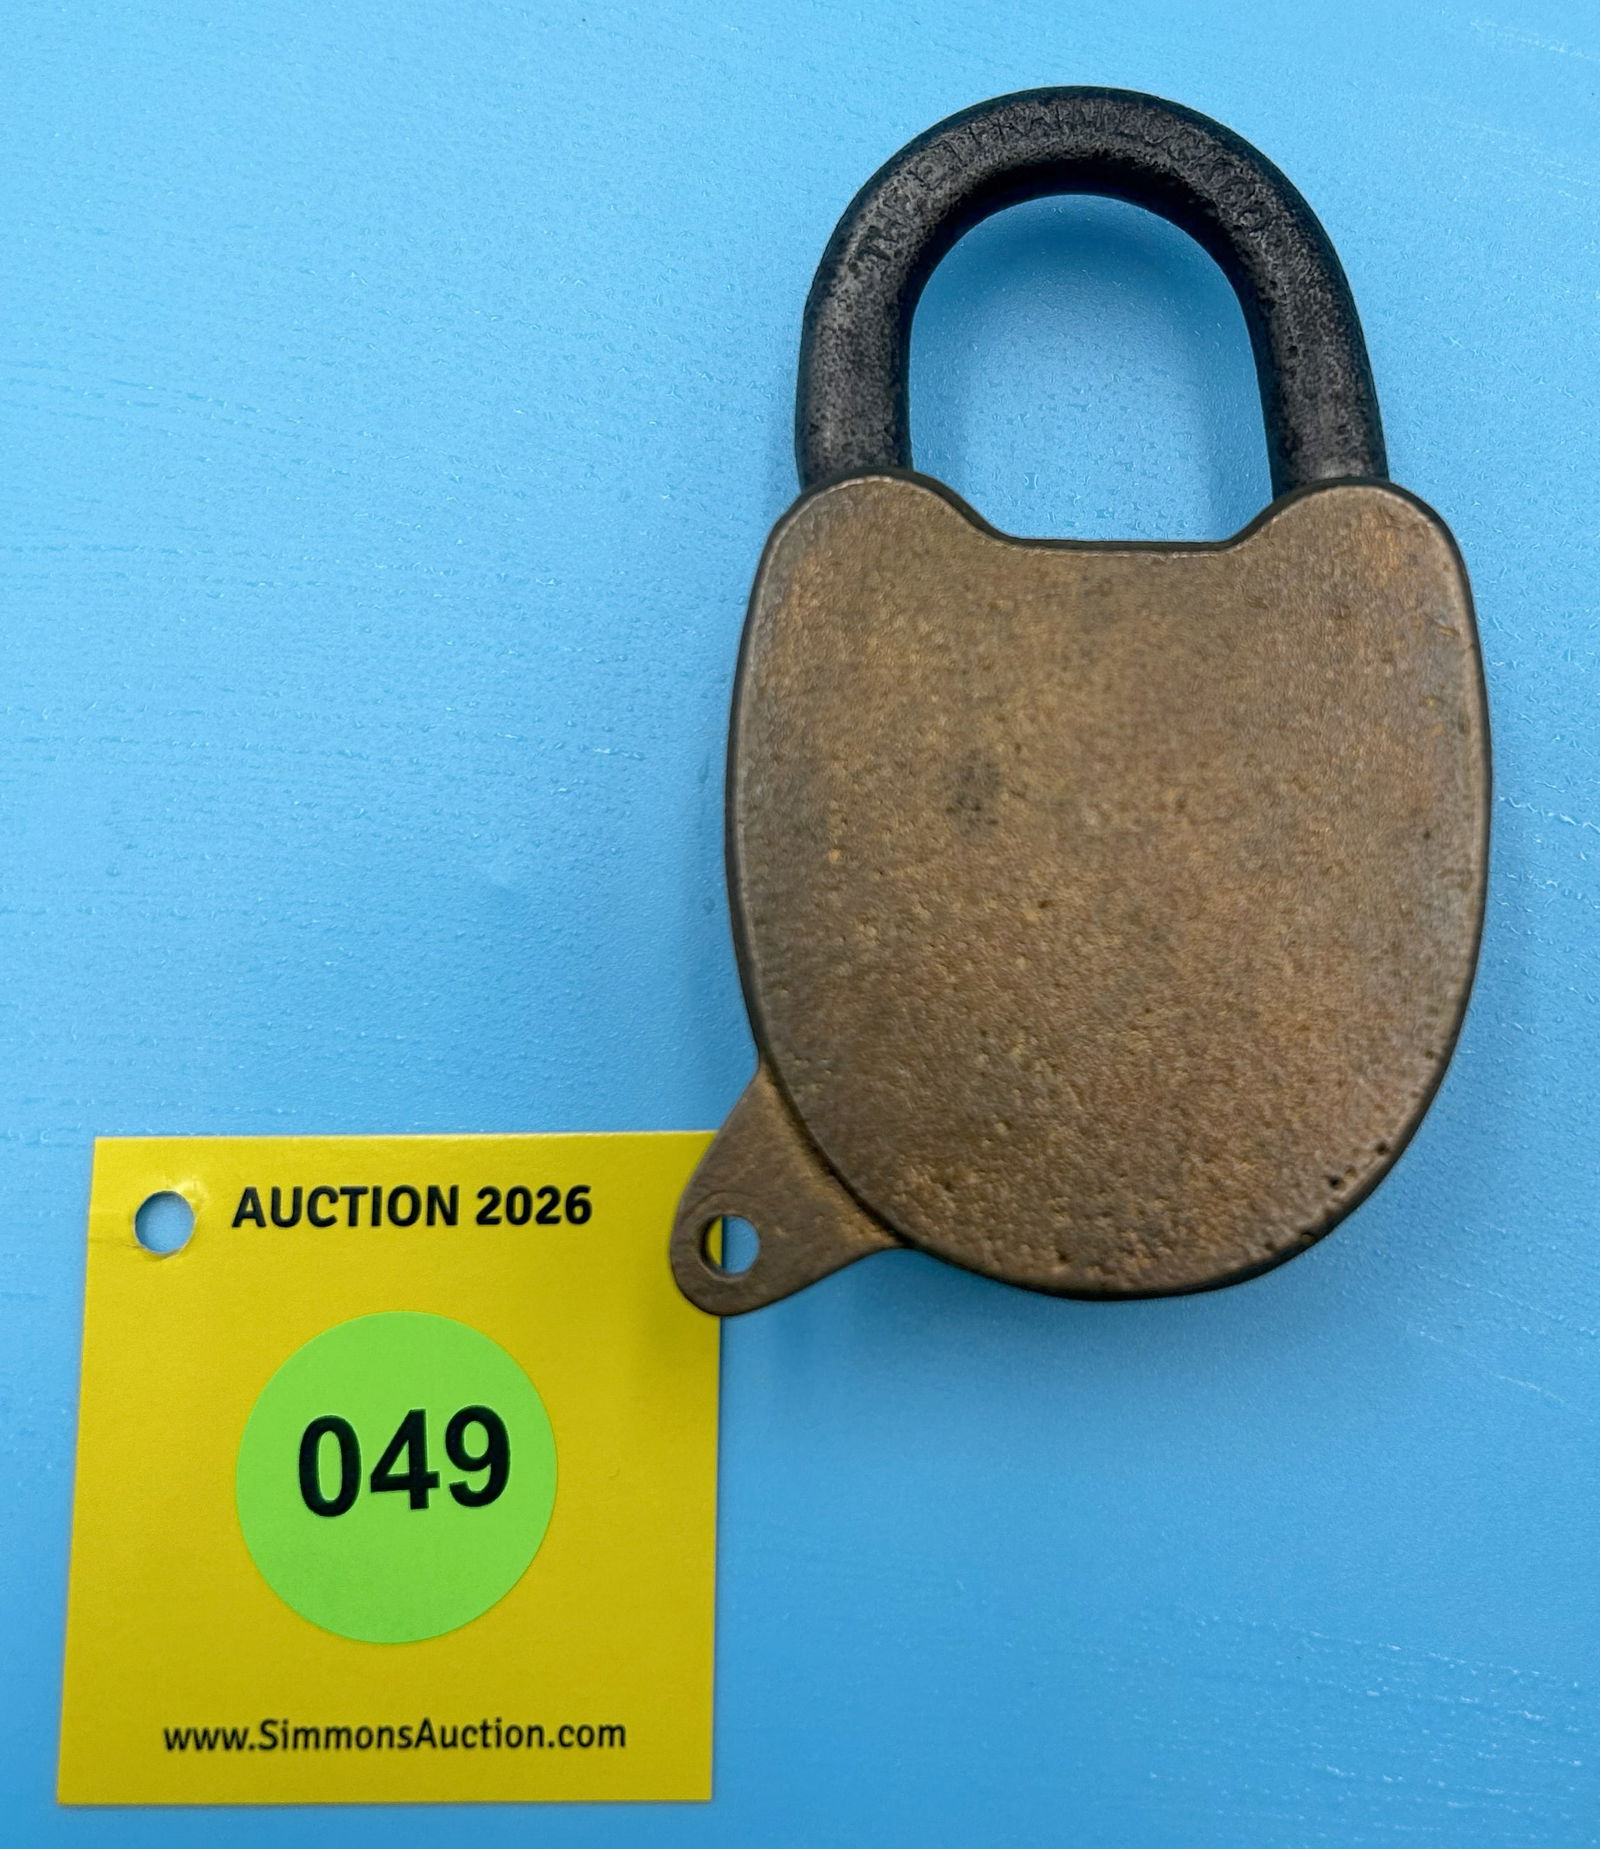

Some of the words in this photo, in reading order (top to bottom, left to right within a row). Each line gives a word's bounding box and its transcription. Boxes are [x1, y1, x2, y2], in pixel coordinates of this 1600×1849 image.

[231, 1185, 459, 1228] AUCTION
[475, 1184, 593, 1226] 2026
[298, 1405, 511, 1518] 049
[163, 1717, 627, 1752] www.SimmonsAuction.com
